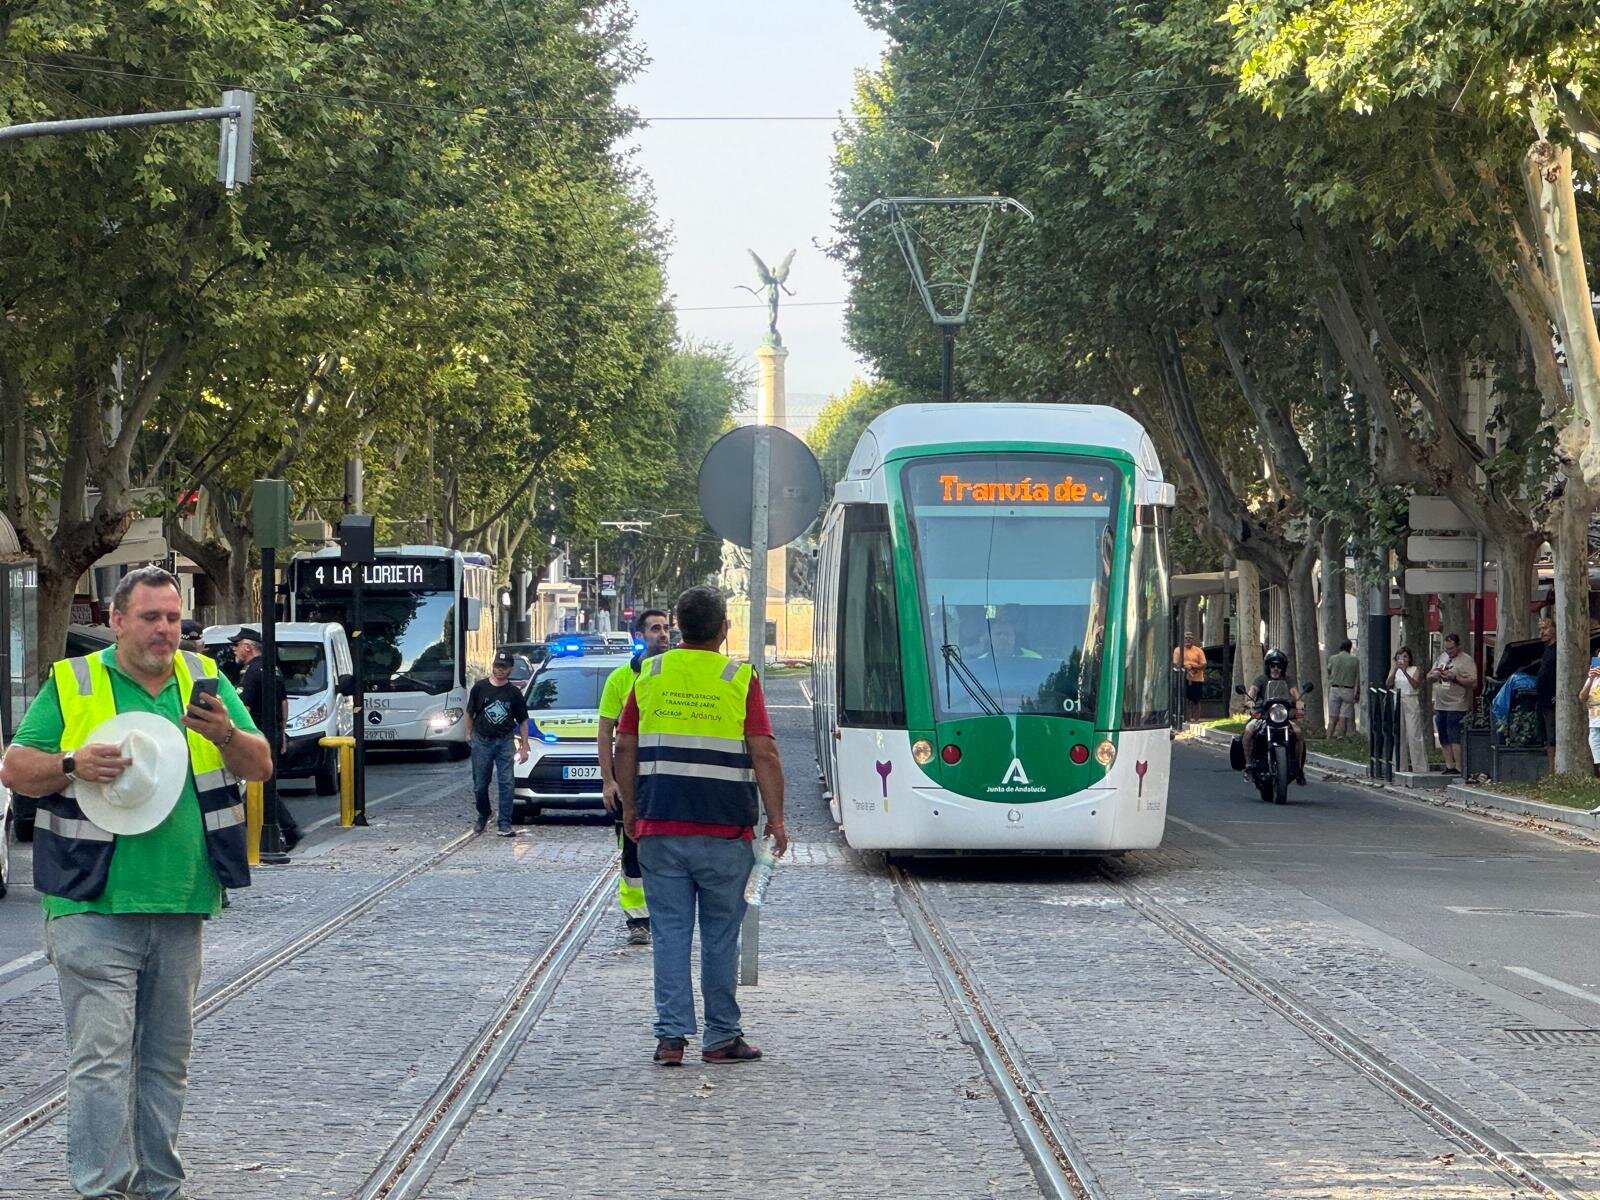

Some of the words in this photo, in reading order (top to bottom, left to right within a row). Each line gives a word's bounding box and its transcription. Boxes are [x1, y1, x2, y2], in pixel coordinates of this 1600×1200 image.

[939, 475, 1049, 501] Tranvía
[1054, 476, 1088, 502] de
[315, 566, 325, 584] 4
[333, 566, 352, 584] LA
[361, 564, 423, 584] LORIETA
[1063, 698, 1081, 711] 01
[690, 711, 722, 722] Ardanuy
[570, 767, 597, 777] 9037
[1014, 785, 1047, 793] Andalucía
